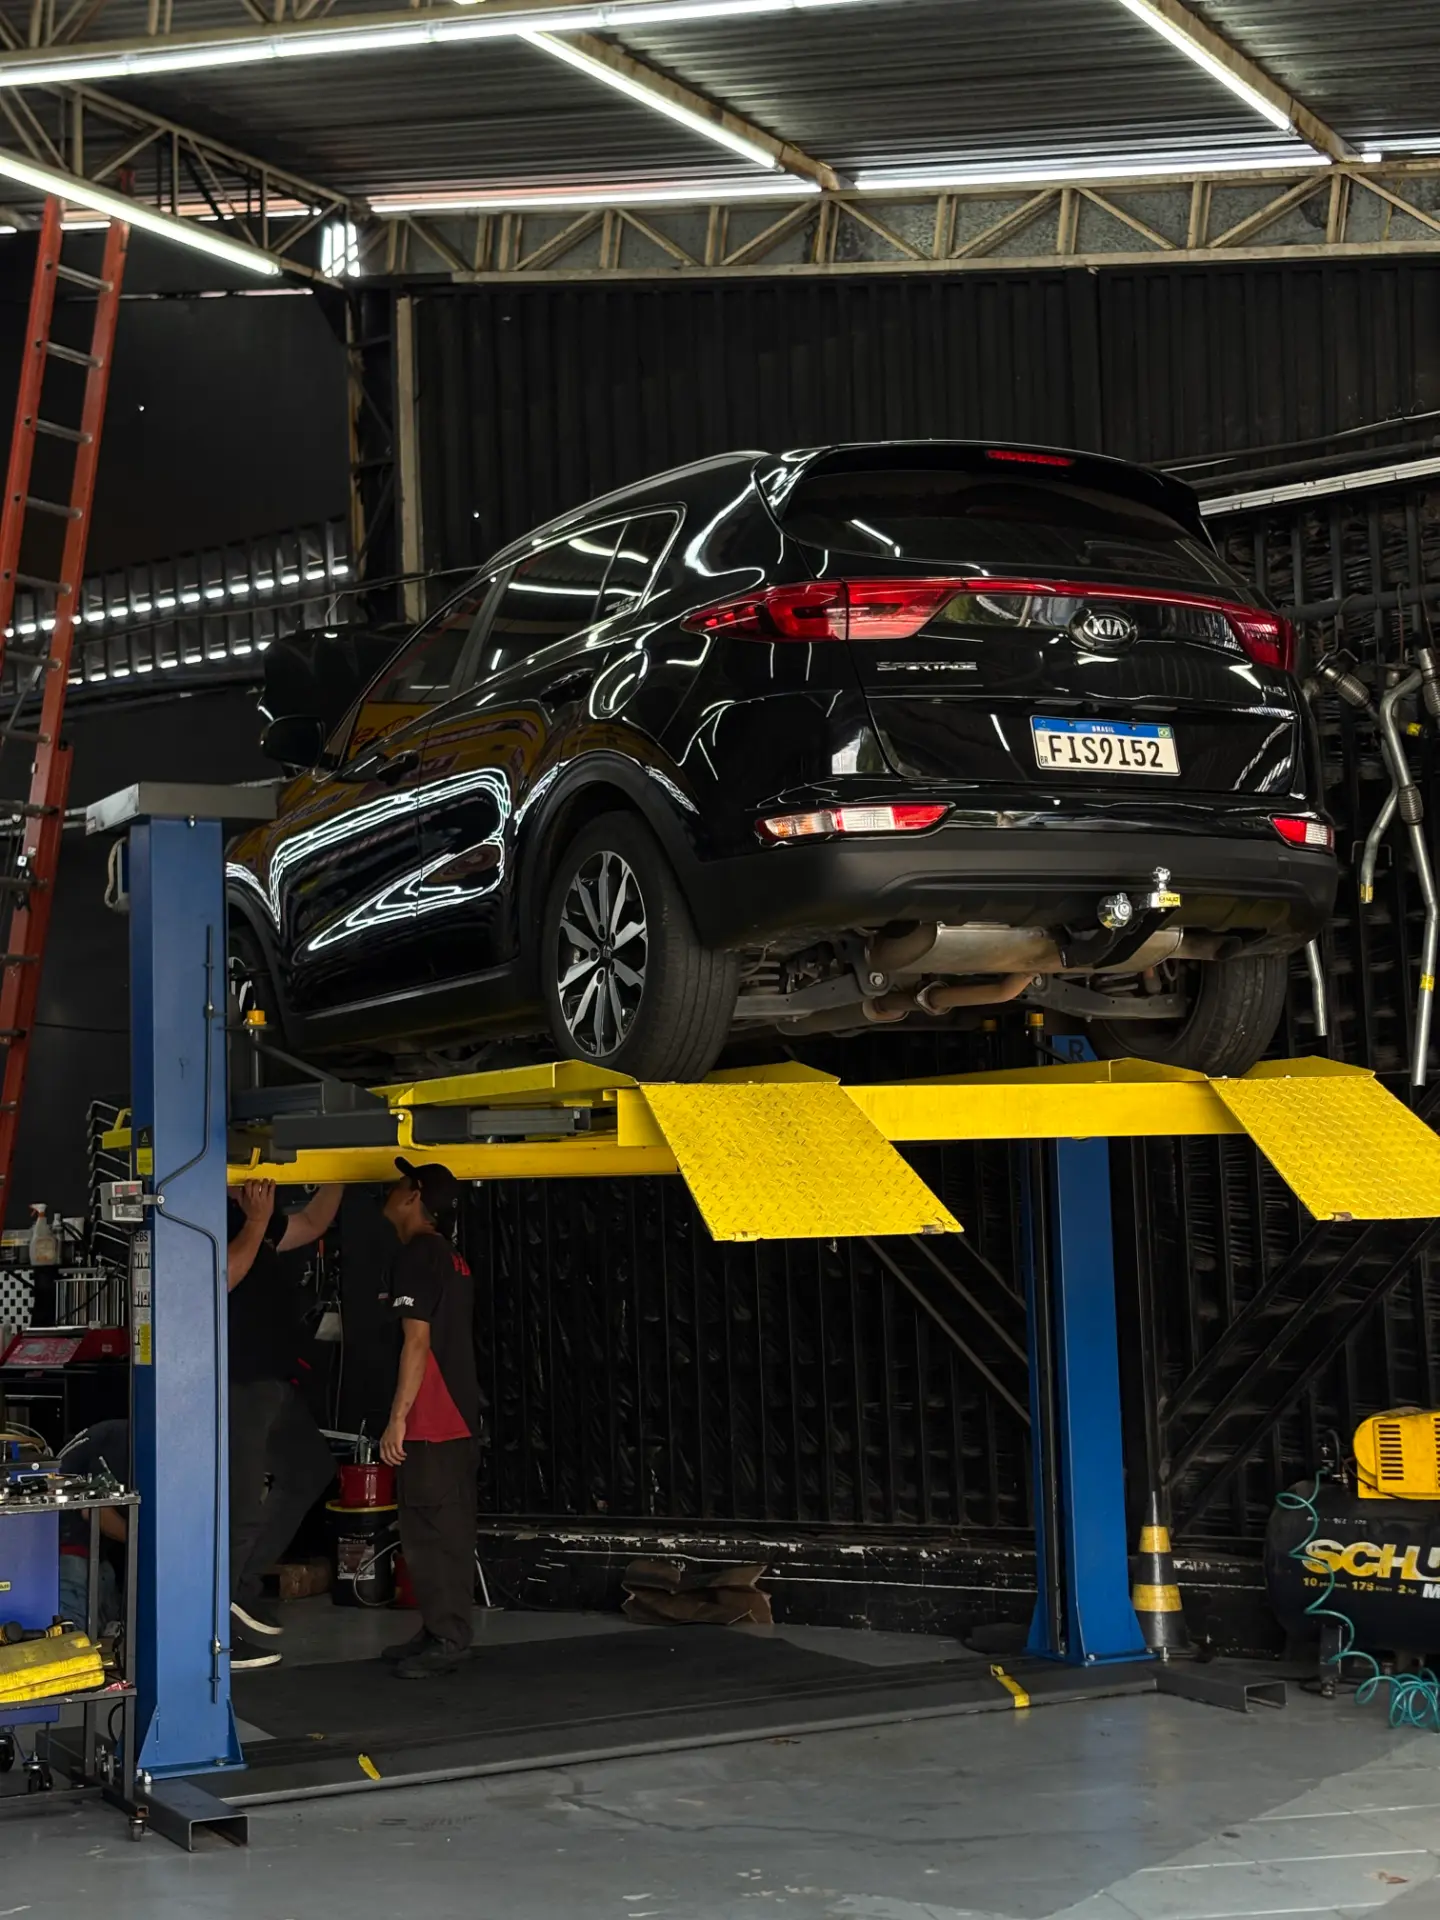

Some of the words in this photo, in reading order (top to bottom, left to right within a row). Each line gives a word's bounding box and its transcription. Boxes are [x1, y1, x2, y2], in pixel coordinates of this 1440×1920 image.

[1092, 618, 1124, 636] KIA
[1091, 725, 1115, 734] BRASIL
[1048, 735, 1163, 768] FIS9I52
[1068, 1039, 1086, 1061] R
[1303, 1577, 1318, 1587] 10
[1351, 1581, 1375, 1592] 175
[1397, 1584, 1406, 1594] 2
